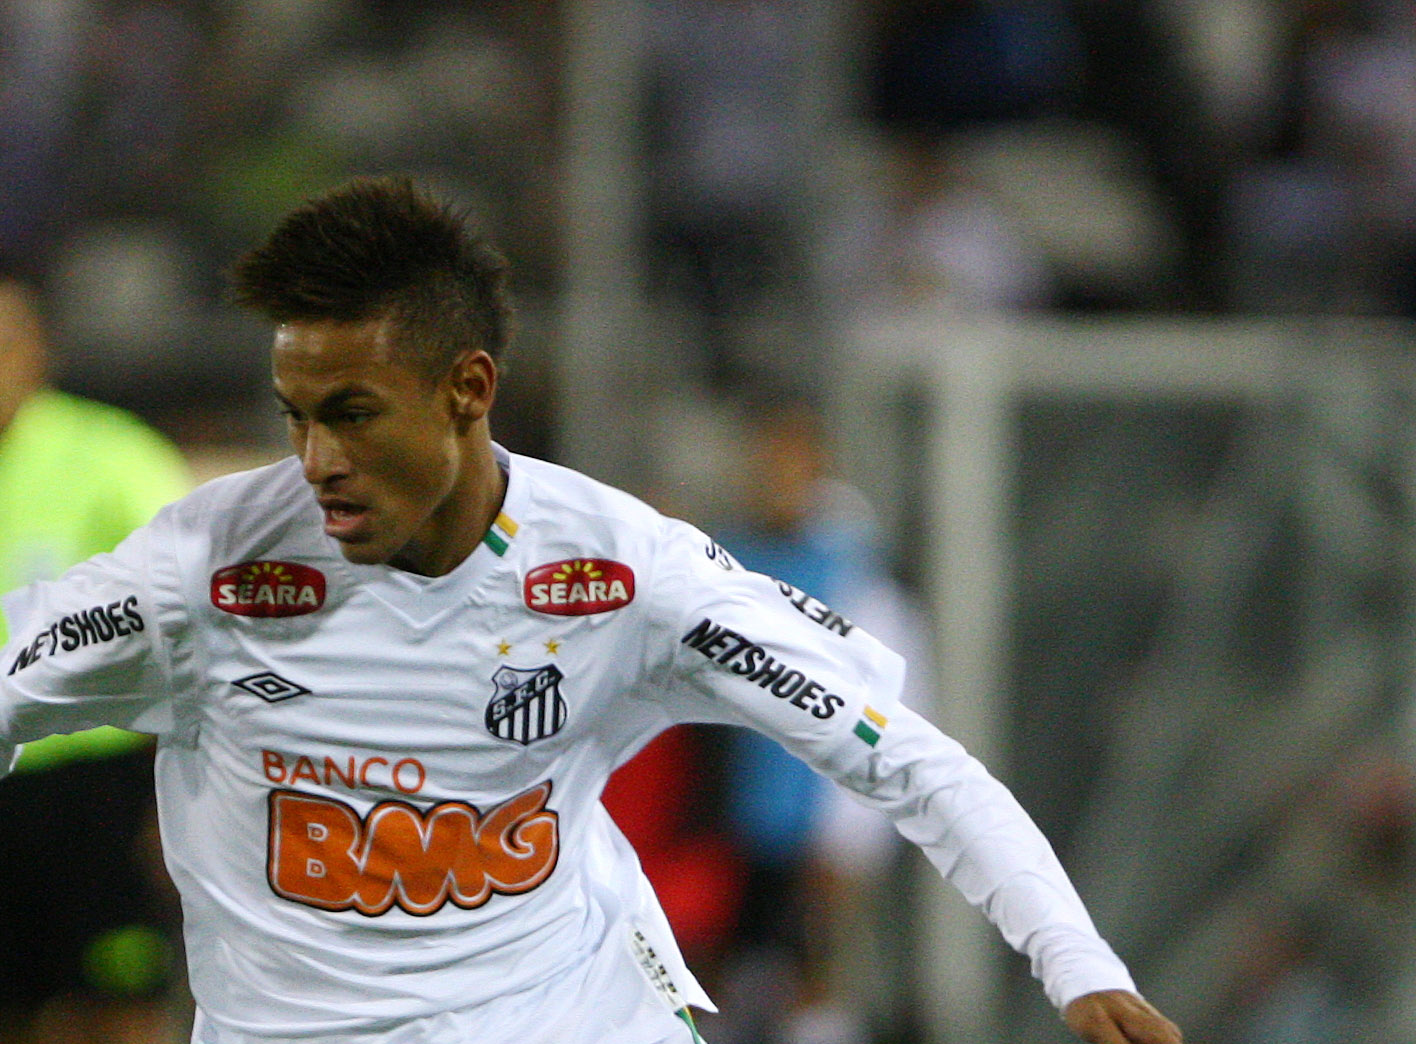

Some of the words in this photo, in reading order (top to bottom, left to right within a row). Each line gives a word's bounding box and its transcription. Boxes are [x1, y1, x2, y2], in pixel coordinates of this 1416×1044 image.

[218, 583, 319, 607] SEARA
[530, 580, 629, 606] SEARA
[8, 595, 145, 677] NETSHOES
[680, 617, 846, 721] NETSHOES
[261, 749, 427, 794] BANCO
[266, 778, 561, 918] BMG
